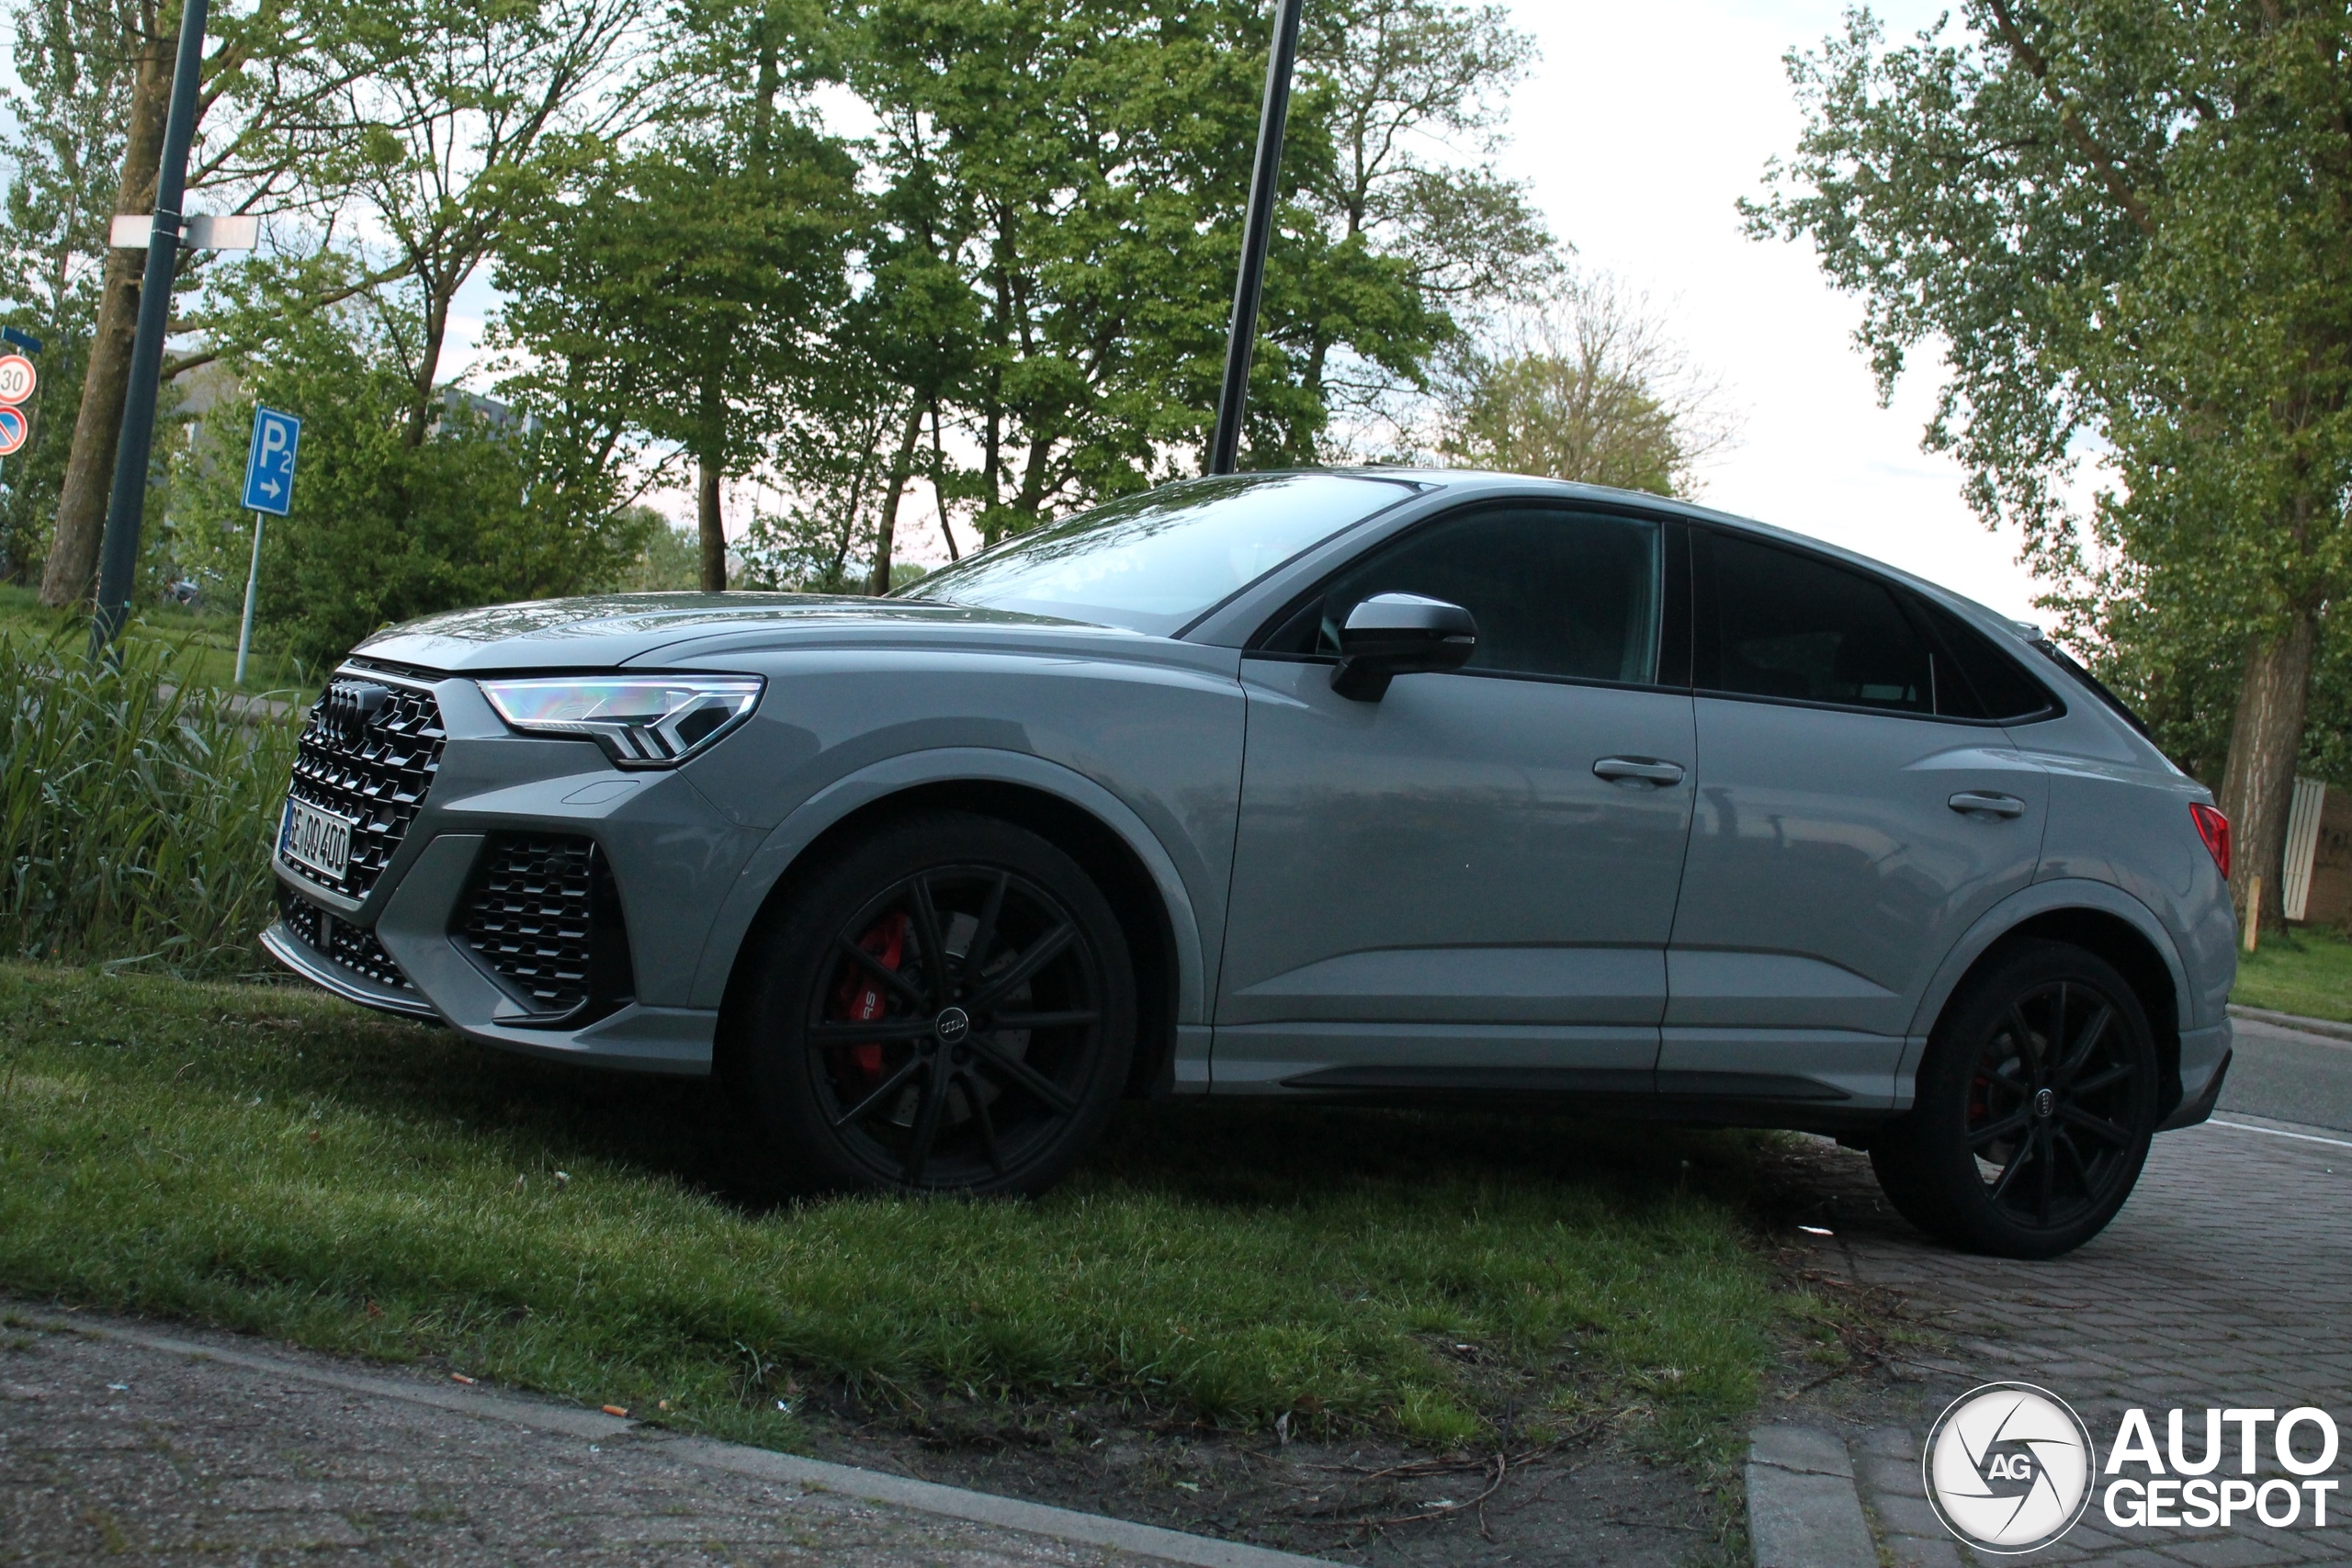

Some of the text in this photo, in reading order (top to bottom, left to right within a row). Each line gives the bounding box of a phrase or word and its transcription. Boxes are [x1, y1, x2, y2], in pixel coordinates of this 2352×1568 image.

[1, 369, 23, 392] 30
[304, 813, 322, 862] QQ
[319, 820, 347, 872] 400
[864, 991, 876, 1019] RS
